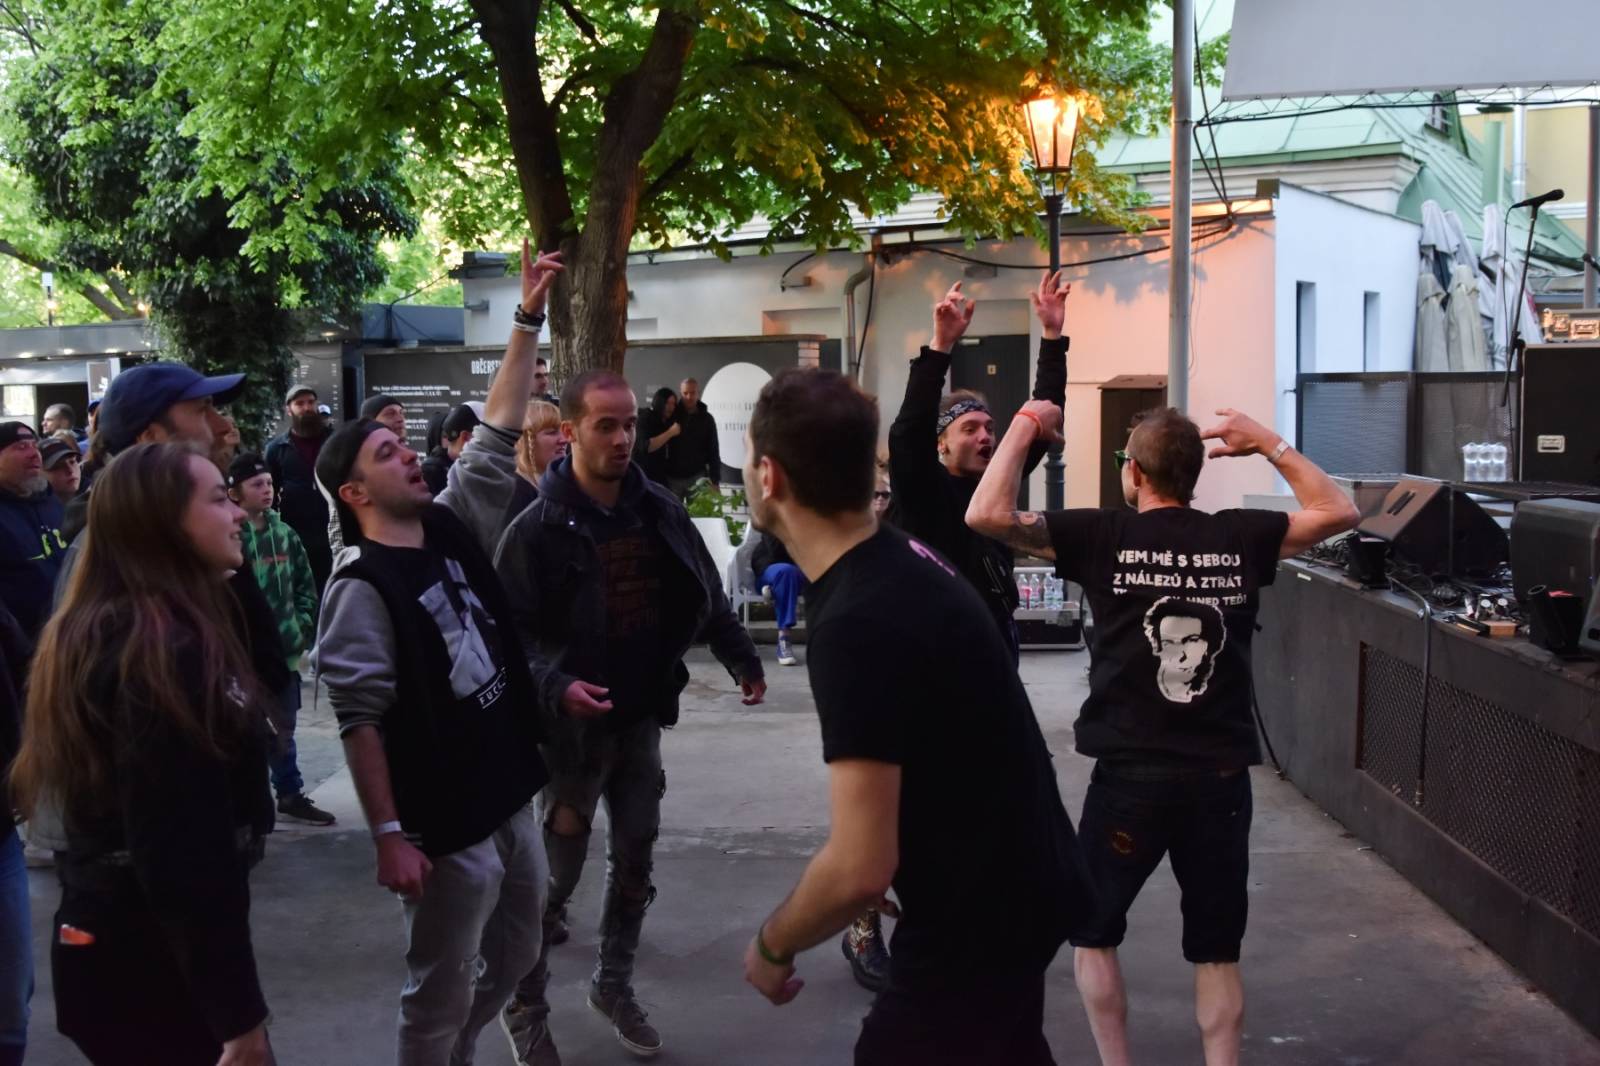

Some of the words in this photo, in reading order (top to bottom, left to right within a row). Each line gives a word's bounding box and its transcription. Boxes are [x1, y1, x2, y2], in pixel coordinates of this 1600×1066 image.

[1116, 550, 1148, 563] VEM
[1152, 550, 1173, 566] MĚ
[1177, 554, 1188, 567] S
[1192, 554, 1241, 568] SEBOU
[1113, 573, 1122, 585] Z
[1185, 576, 1197, 588] A
[1200, 573, 1242, 588] ZTRÁT
